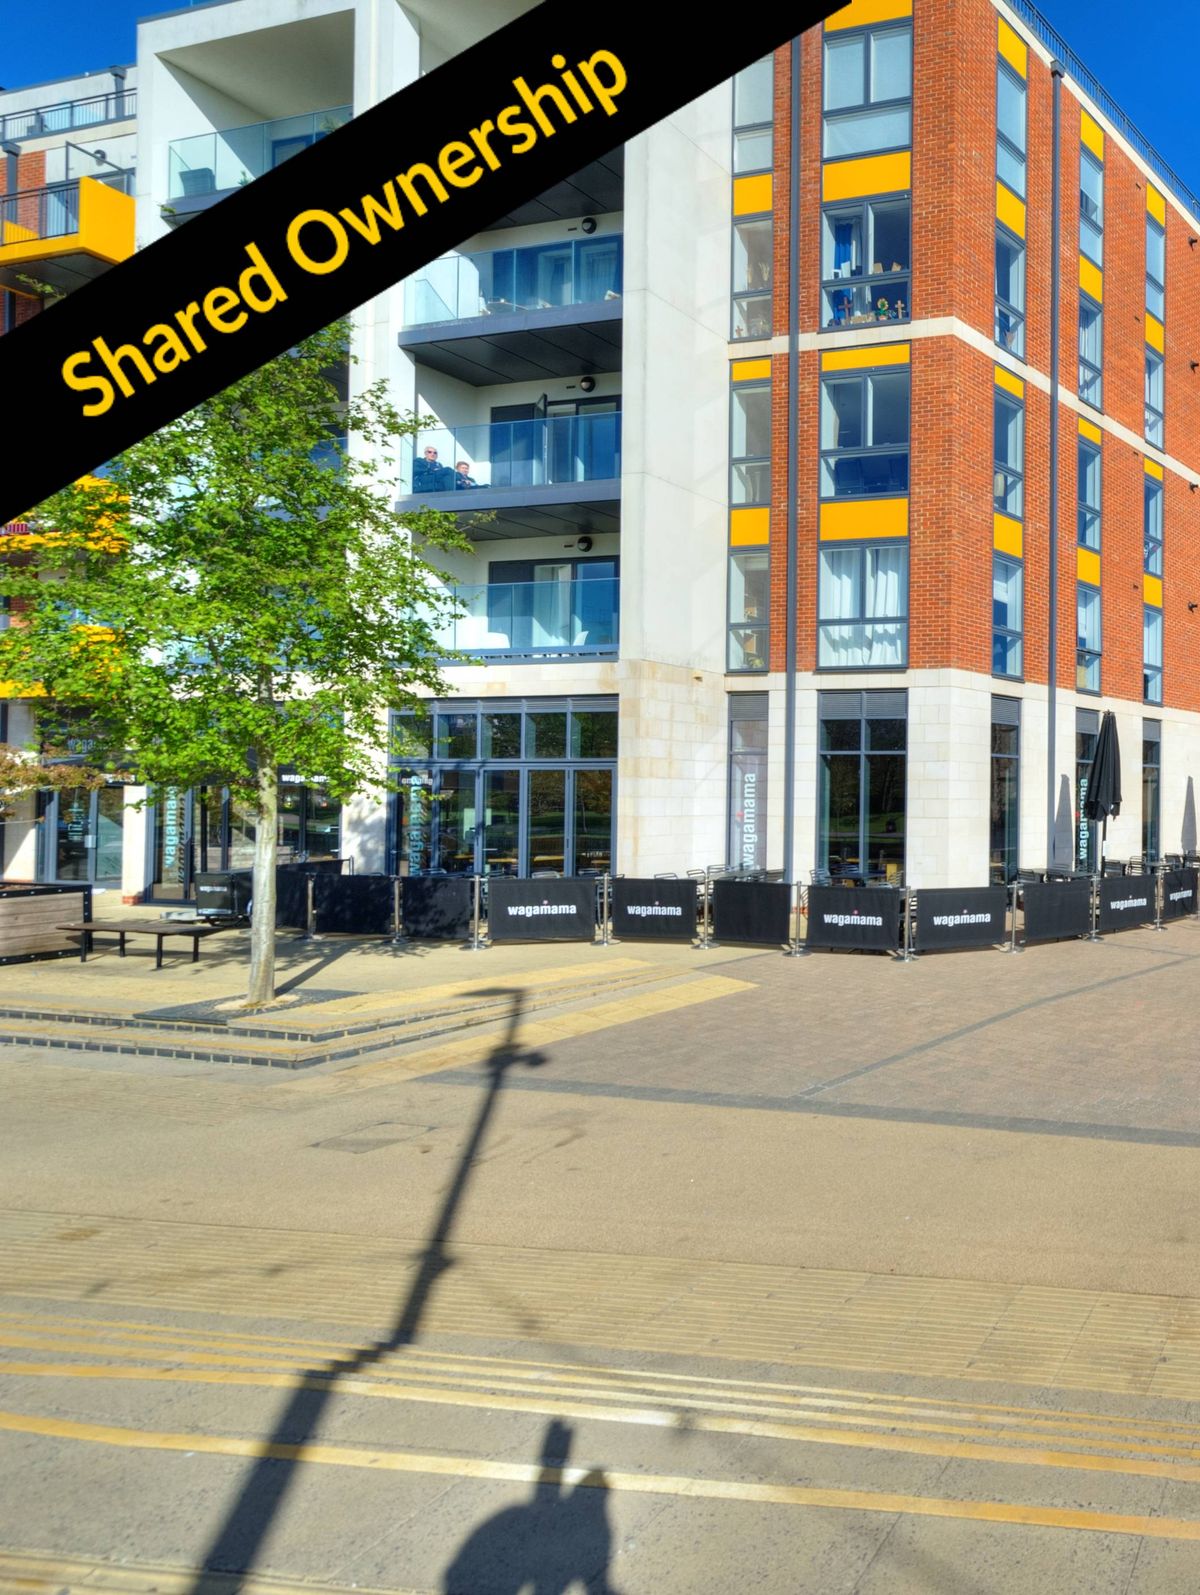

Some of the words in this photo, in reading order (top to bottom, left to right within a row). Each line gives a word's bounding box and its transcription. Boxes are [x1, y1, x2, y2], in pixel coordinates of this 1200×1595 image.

[281, 774, 331, 784] wagaam
[743, 773, 758, 867] wagamama
[164, 786, 179, 868] wagamaa
[507, 904, 577, 917] wagamama
[626, 904, 683, 917] wagamama
[1110, 898, 1147, 911] wagamama
[823, 913, 883, 926] wagamama
[932, 912, 991, 927] wagamama
